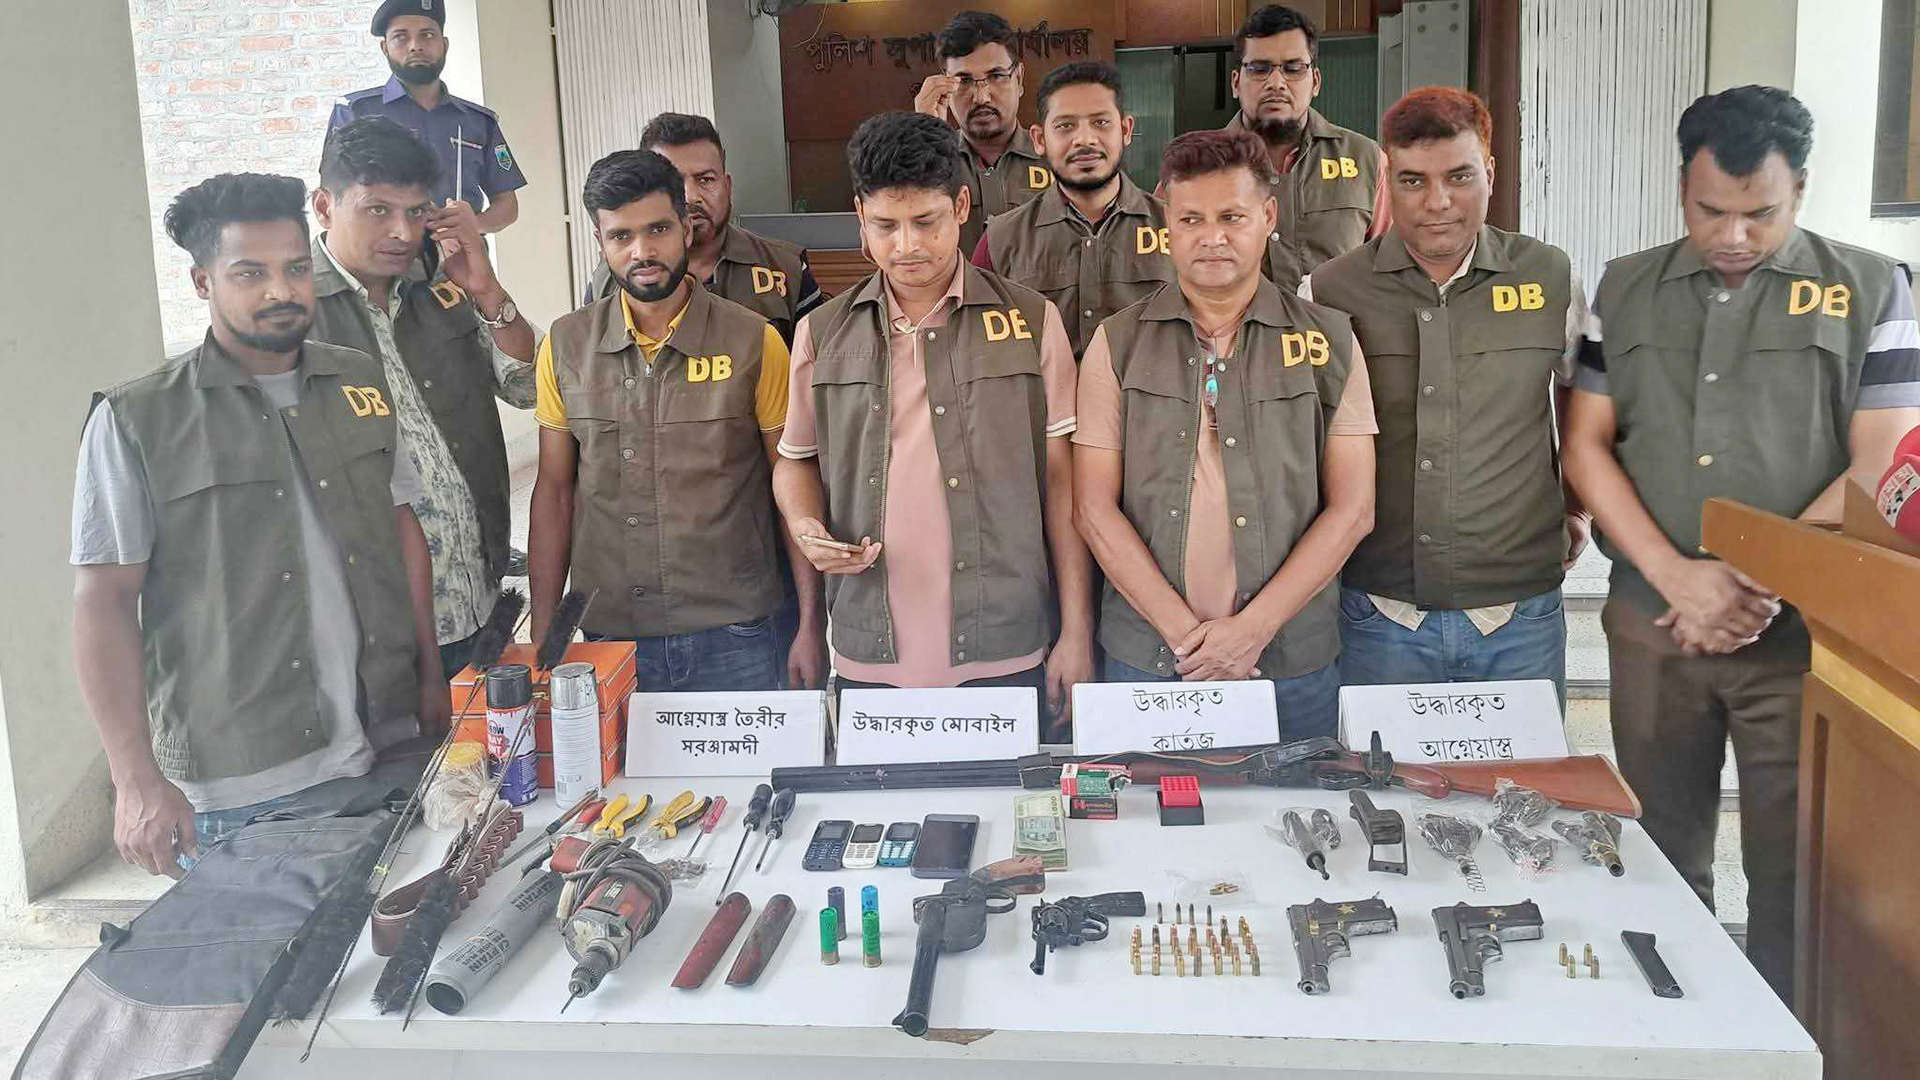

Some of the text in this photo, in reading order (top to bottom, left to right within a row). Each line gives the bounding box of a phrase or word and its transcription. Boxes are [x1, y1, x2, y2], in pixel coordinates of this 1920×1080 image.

[804, 30, 876, 72] পুলিশ
[1029, 165, 1049, 188] D
[1321, 157, 1359, 179] DB
[430, 280, 470, 309] D
[1492, 283, 1545, 312] DB
[1789, 280, 1850, 318] DB
[1281, 330, 1330, 367] DB
[687, 354, 733, 383] DB
[342, 385, 391, 417] DB
[1132, 687, 1224, 716] উদ্ধারকৃত
[1407, 690, 1506, 722] উদ্ধারকৃত
[734, 706, 787, 729] তৈরীর
[852, 711, 1017, 737] উদ্ধারকৃত মোবাইল
